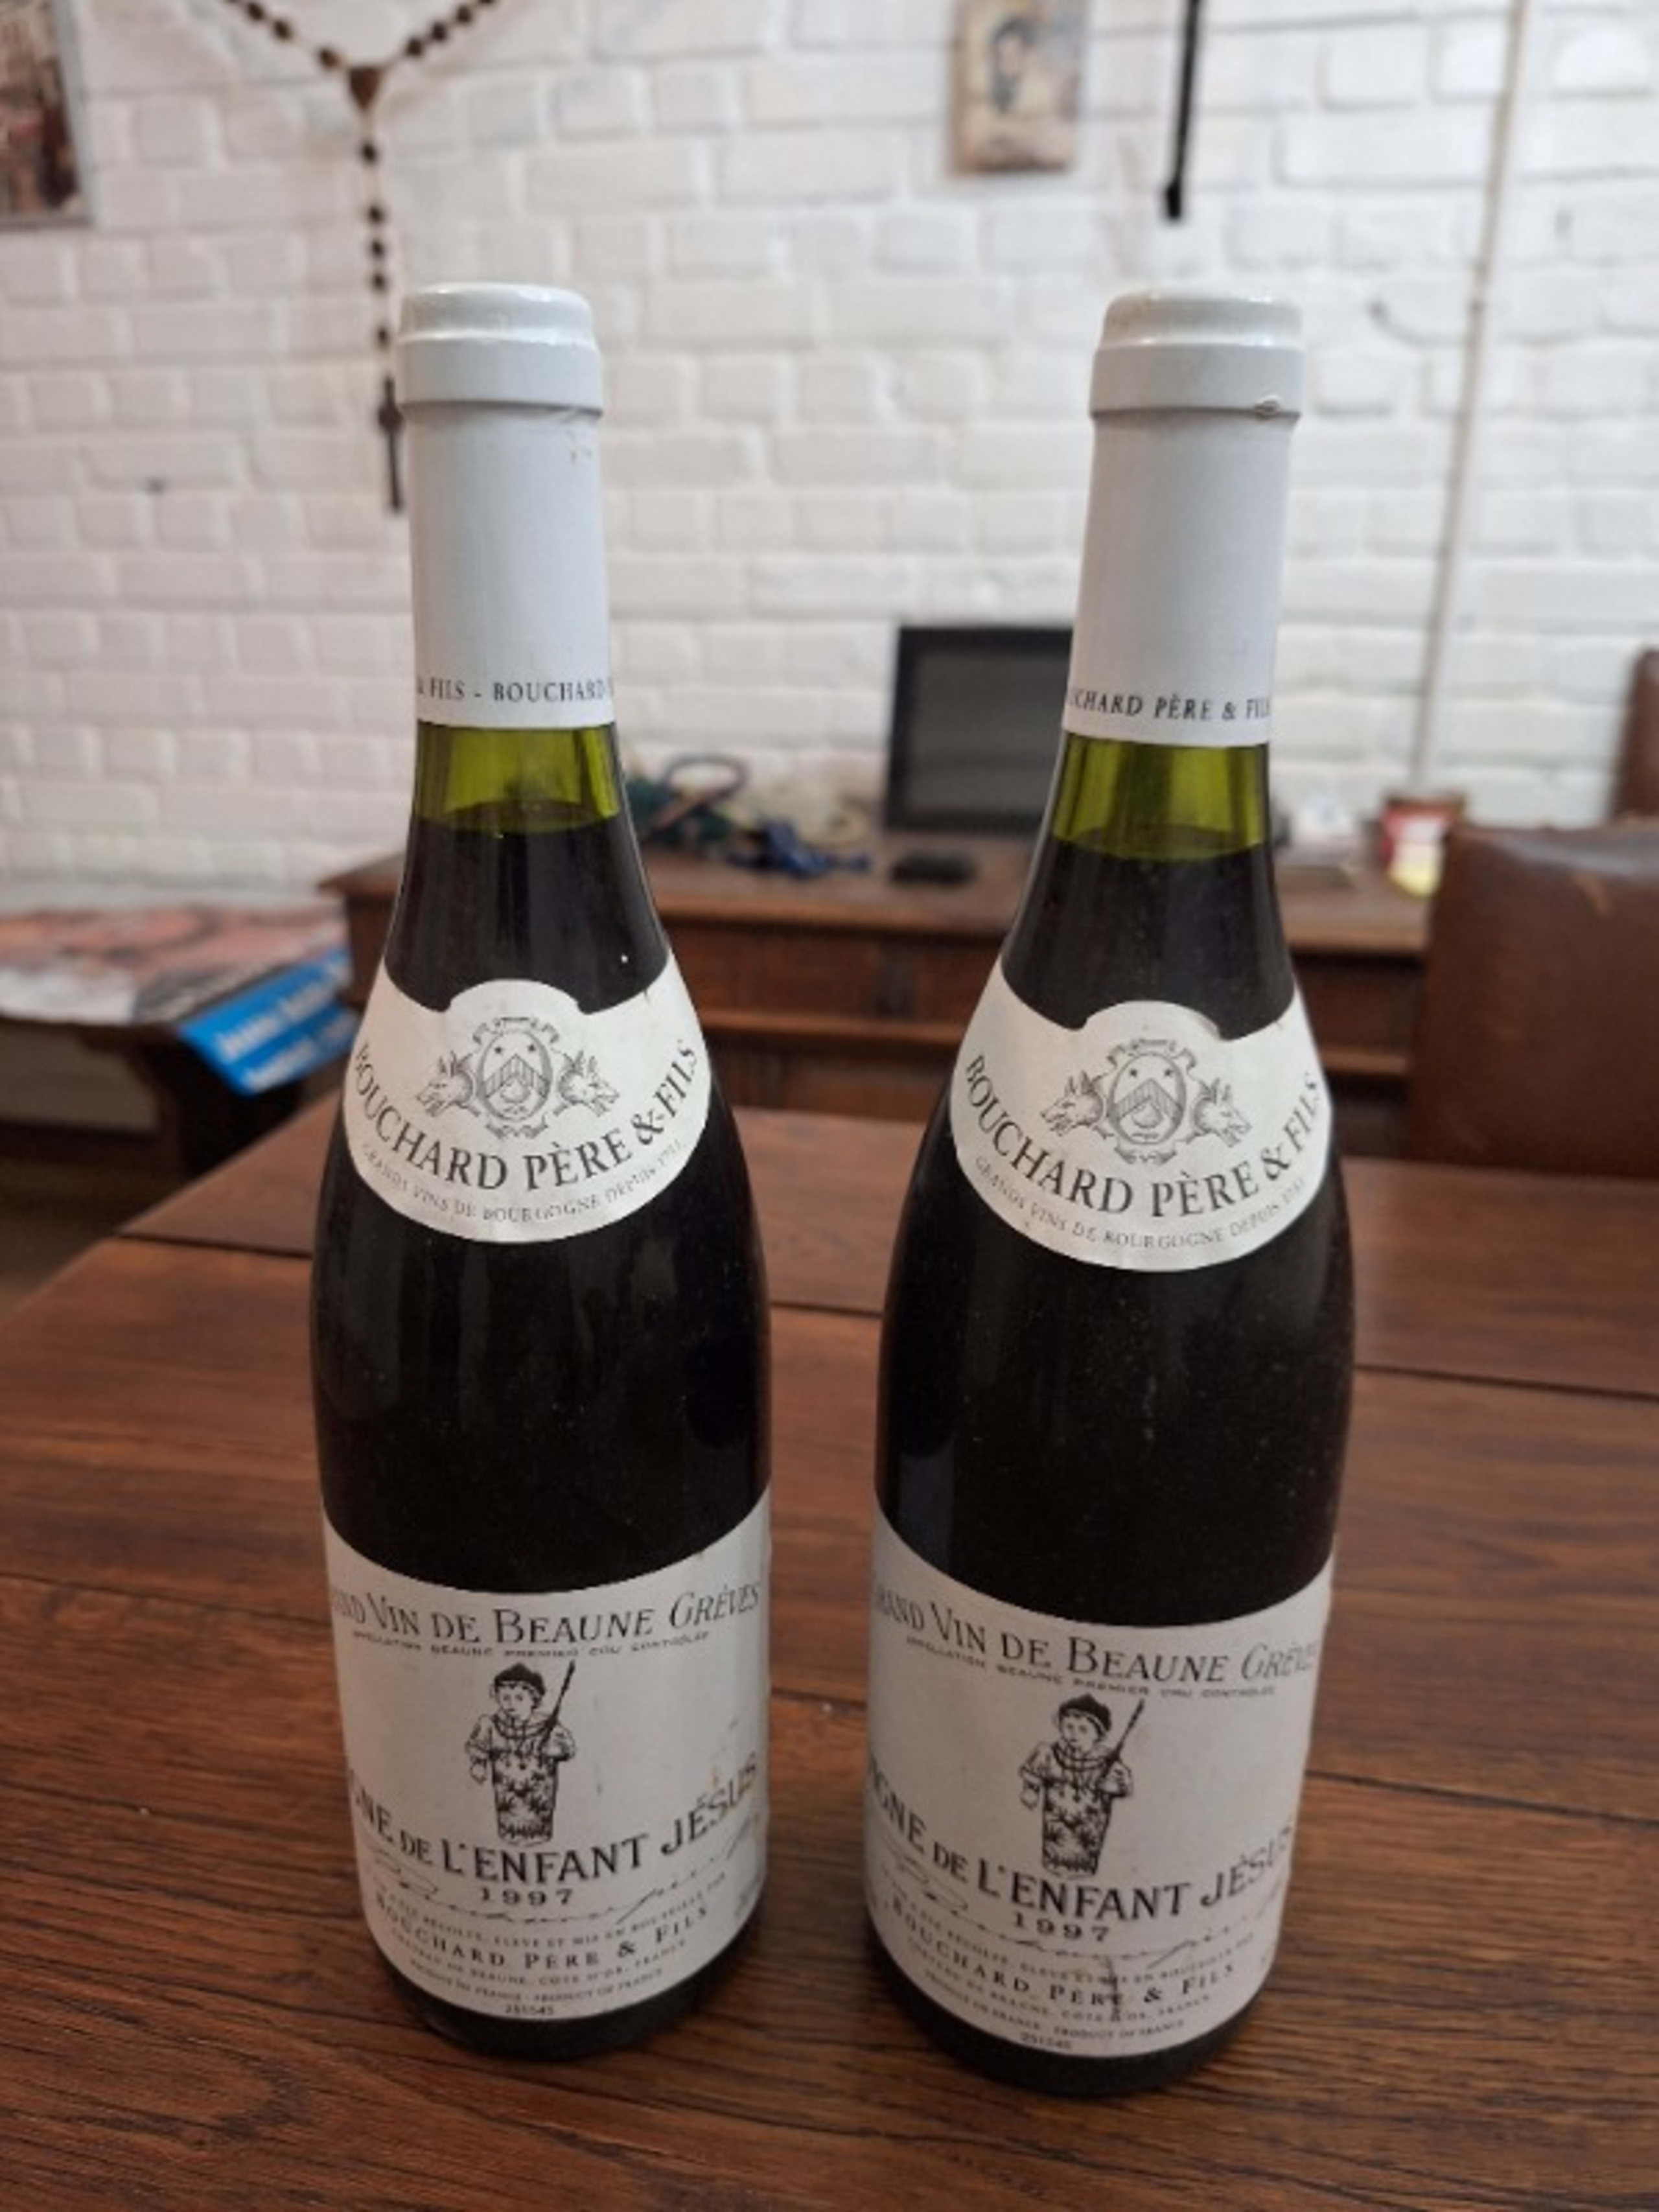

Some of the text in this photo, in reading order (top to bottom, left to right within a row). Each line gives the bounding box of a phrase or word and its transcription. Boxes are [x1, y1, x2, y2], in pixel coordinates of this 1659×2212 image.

[493, 681, 608, 703] BOUCHARD
[1069, 688, 1144, 717] CHARD
[1154, 693, 1213, 721] PÈRE
[1221, 700, 1236, 720] &
[354, 1042, 508, 1191] BOUCHARD
[522, 1128, 634, 1191] PÈRE
[630, 1109, 665, 1147] &
[652, 1038, 699, 1119] FILS
[964, 1054, 1133, 1215] BOUCHARD
[1151, 1161, 1259, 1218] PÈRE
[1259, 1141, 1293, 1183] &
[1102, 1228, 1225, 1250] BOURGOGNE
[430, 1611, 481, 1644] DE
[491, 1608, 656, 1644] BEAUNE
[668, 1583, 761, 1629] GRÈVES
[929, 1601, 987, 1655] VIN
[999, 1631, 1052, 1668] DE
[1067, 1635, 1230, 1682] BEAUNE
[400, 1829, 434, 1866] DE
[440, 1832, 651, 1884] L'ENFANT
[933, 1839, 969, 1884] DE
[977, 1851, 1194, 1920] L'ENFANT
[480, 1885, 574, 1907] 1997
[1013, 1903, 1111, 1943] 1997
[616, 1940, 638, 1959] &
[655, 1903, 708, 1945] FILS
[1143, 1986, 1163, 2004] &
